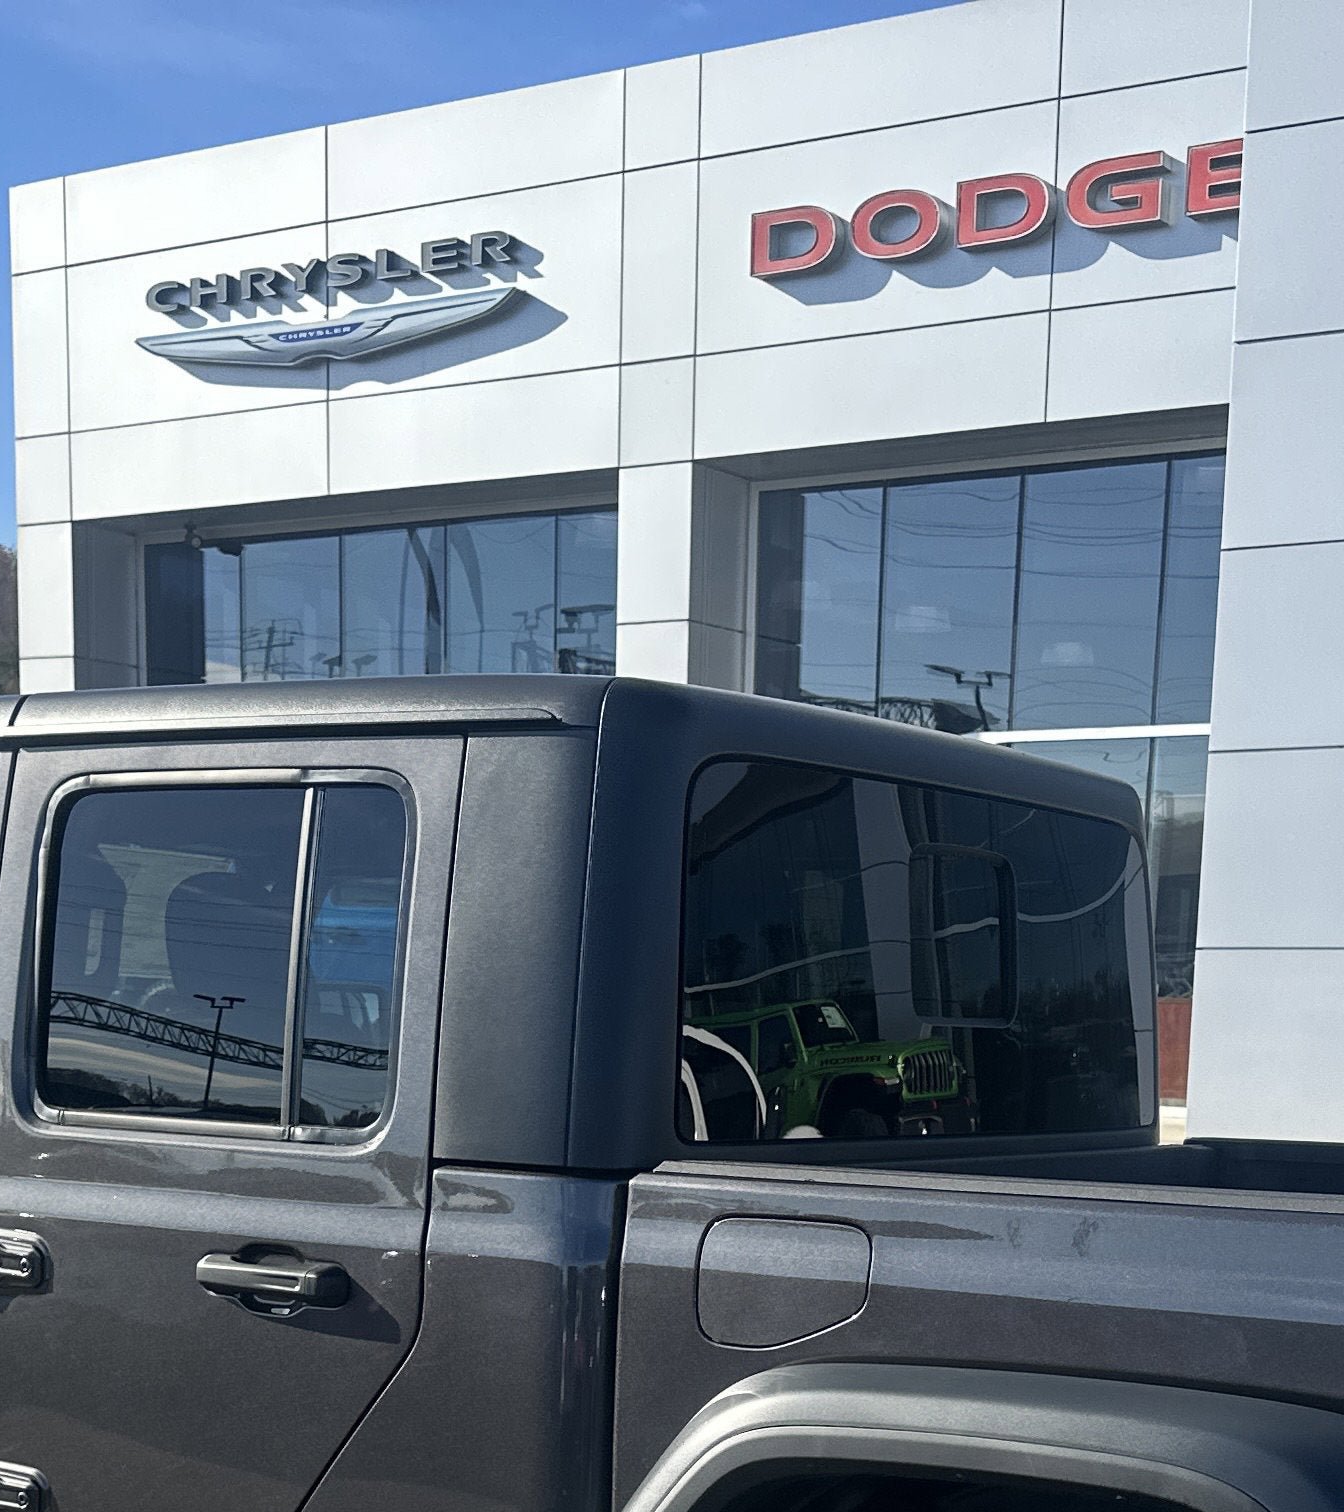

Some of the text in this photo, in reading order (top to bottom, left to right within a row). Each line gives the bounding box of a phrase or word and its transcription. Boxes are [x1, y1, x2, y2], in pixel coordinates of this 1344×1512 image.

[751, 138, 1244, 278] DODGE
[145, 230, 513, 313] CHRYSLER
[278, 326, 351, 341] CHRYSLER
